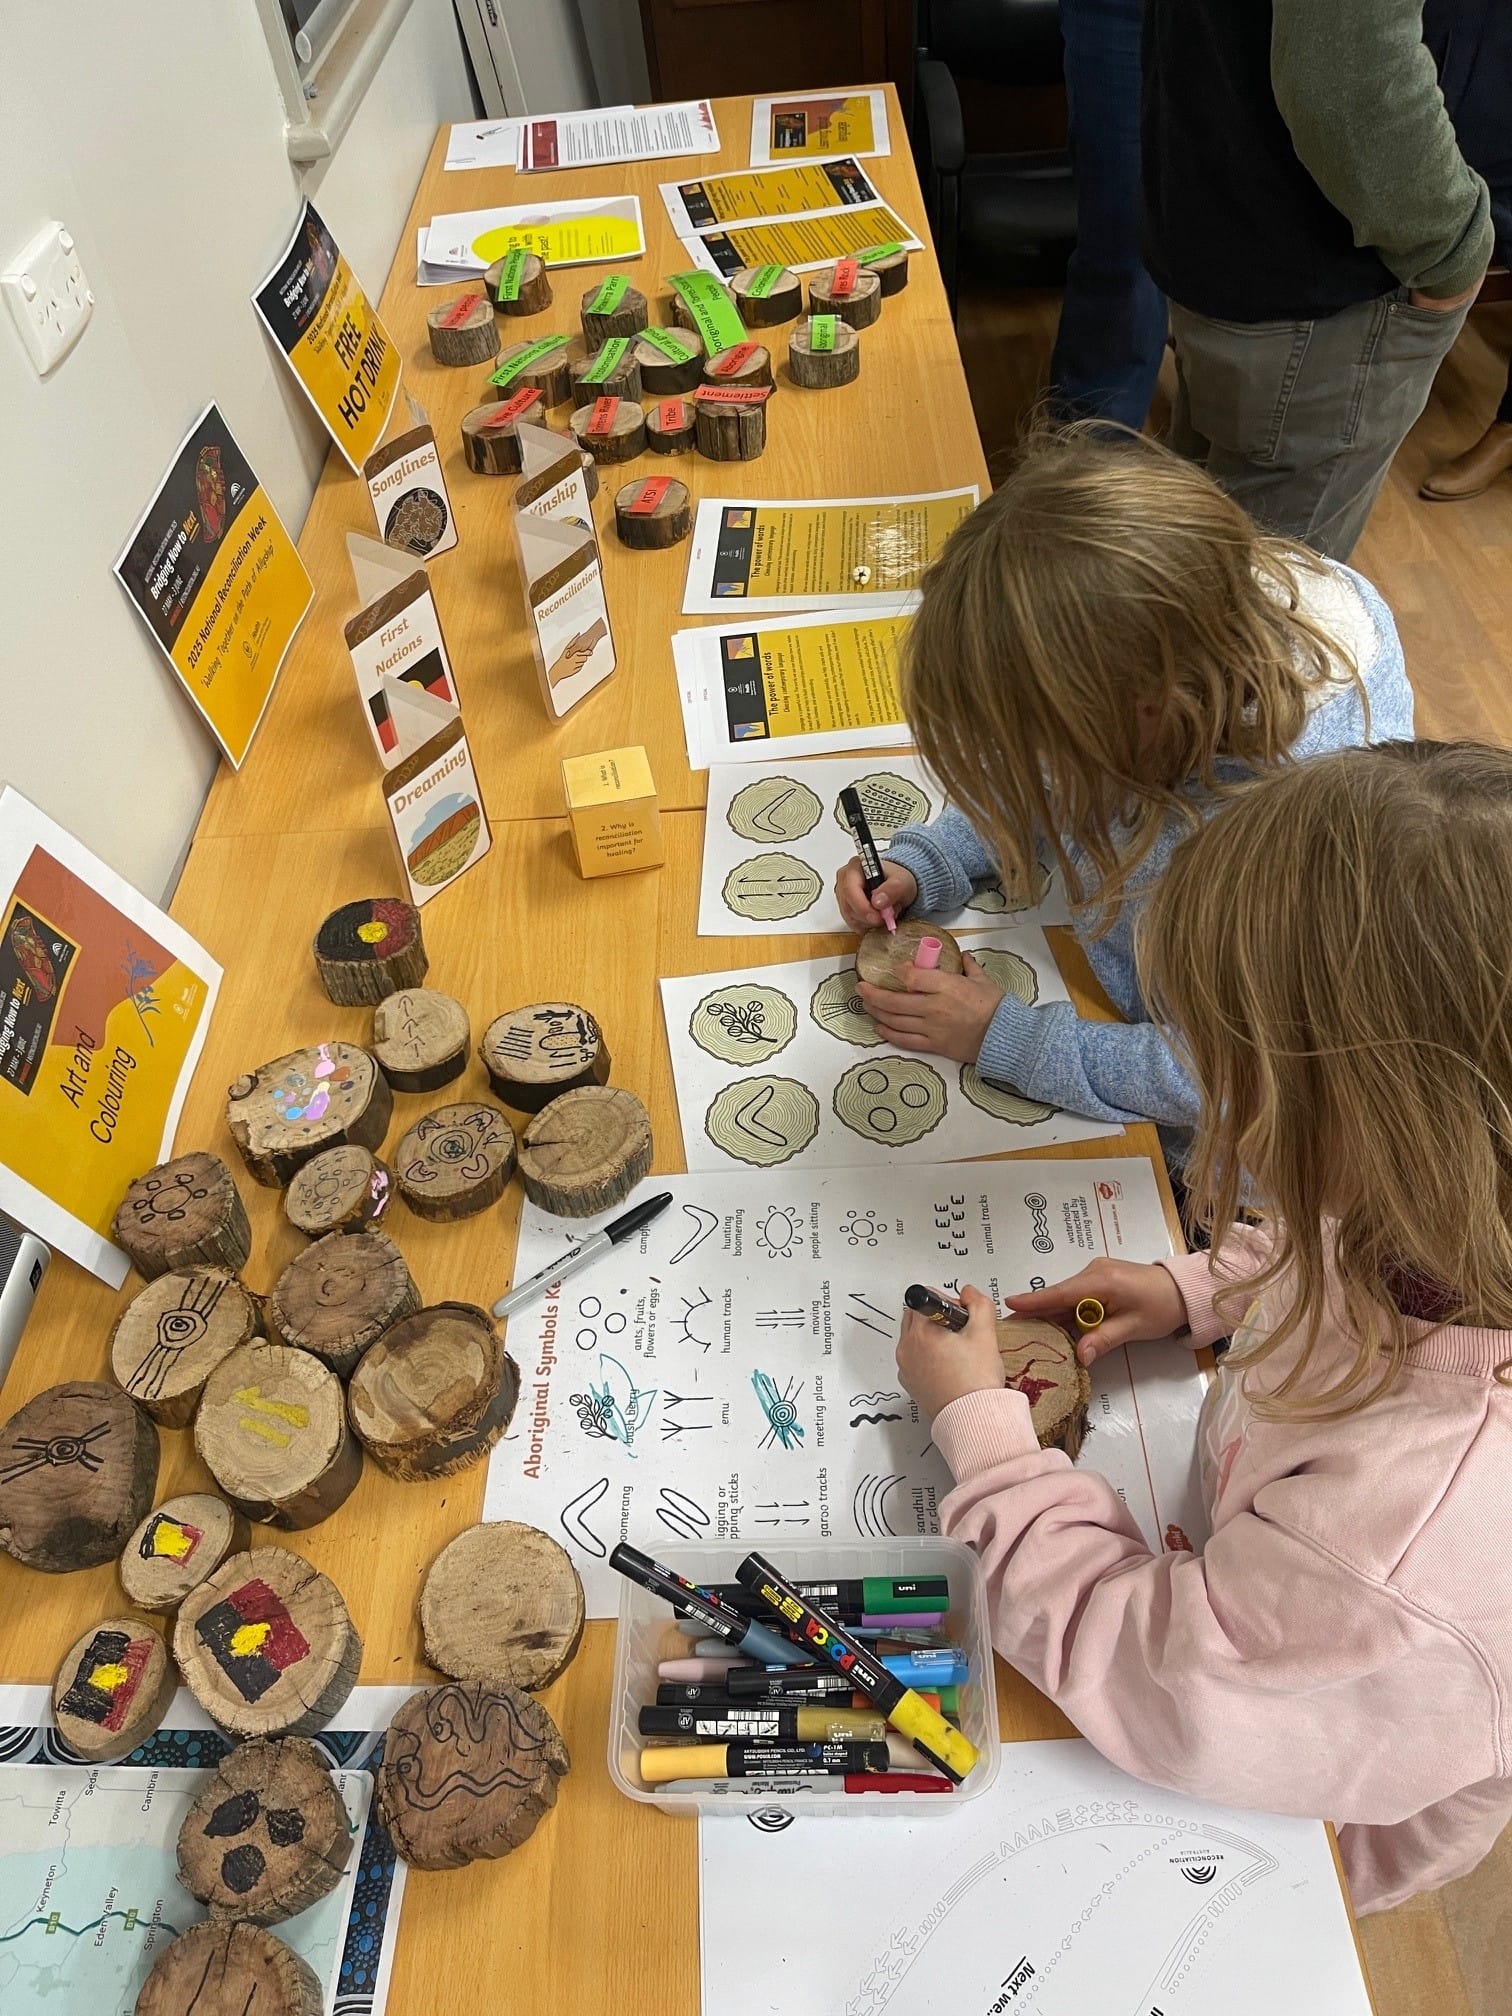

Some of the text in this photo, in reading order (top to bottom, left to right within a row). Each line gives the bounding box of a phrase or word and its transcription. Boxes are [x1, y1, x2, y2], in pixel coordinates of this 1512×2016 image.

[334, 311, 363, 371] FREE
[702, 318, 723, 354] boriginal
[338, 321, 388, 430] HOT DRINK
[492, 366, 510, 384] First
[702, 388, 768, 400] Settlement
[665, 406, 676, 427] Tribe
[372, 451, 436, 498] Songlines
[530, 481, 578, 516] Kinship
[643, 489, 658, 505] ATSI
[757, 525, 766, 541] words
[150, 556, 174, 601] Bridging
[168, 538, 182, 567] Now
[750, 567, 760, 578] The
[753, 549, 764, 567] power
[187, 515, 268, 670] 2025 National Reconciliation Week
[537, 567, 599, 622] Reconciliation
[216, 618, 236, 659] Together
[241, 581, 254, 606] Path
[379, 617, 410, 649] First
[375, 634, 423, 677] Nations
[763, 651, 773, 671] words
[766, 680, 778, 702] power
[769, 702, 779, 717] The
[394, 748, 467, 815] Dreaming
[595, 830, 643, 841] reconciliation
[596, 837, 644, 852] important for
[610, 822, 627, 832] Why
[606, 848, 636, 859] healing?
[12, 977, 26, 1001] Next
[59, 1025, 97, 1110] Art and
[90, 1045, 137, 1145] Colouring
[722, 1214, 733, 1251] hunting
[732, 1208, 745, 1258] boomerang
[808, 1201, 824, 1260] people sitting
[895, 1218, 905, 1236] star
[981, 1193, 995, 1256] animal tracks
[1061, 1202, 1075, 1244] waterholes
[1070, 1197, 1086, 1248] connected by
[1079, 1195, 1095, 1251] running water
[633, 1295, 648, 1353] ants, fruits,
[643, 1287, 660, 1358] flowers or eggs
[721, 1287, 733, 1354] human tracks
[810, 1298, 824, 1335] moving
[820, 1280, 833, 1355] kangaroo tracks
[523, 1277, 567, 1480] Aboriginal Symbols Ke
[623, 1388, 640, 1445] bush berry
[720, 1402, 730, 1425] emu
[814, 1374, 829, 1448] meeting place
[1100, 1392, 1112, 1415] rain
[619, 1485, 635, 1542] oomerang
[714, 1485, 728, 1541] igging or
[728, 1472, 742, 1541] pping sticks
[819, 1466, 833, 1538] garoo tracks
[915, 1486, 928, 1535] sandhill
[926, 1485, 939, 1535] or cloud
[898, 1583, 917, 1592] uni
[806, 1617, 856, 1670] POSCA
[918, 1652, 938, 1660] uni
[851, 1665, 876, 1687] uni
[48, 1789, 66, 1827] Towitta
[141, 1770, 159, 1812] Cambrai
[1169, 1854, 1225, 1864] RECONCILIATION
[35, 1864, 57, 1913] Keyneton
[48, 1914, 58, 1931] B10
[93, 1885, 119, 1948] Eden Valley
[126, 1910, 136, 1928] B10
[143, 1898, 164, 1952] Springton
[1007, 1962, 1035, 1996] Next
